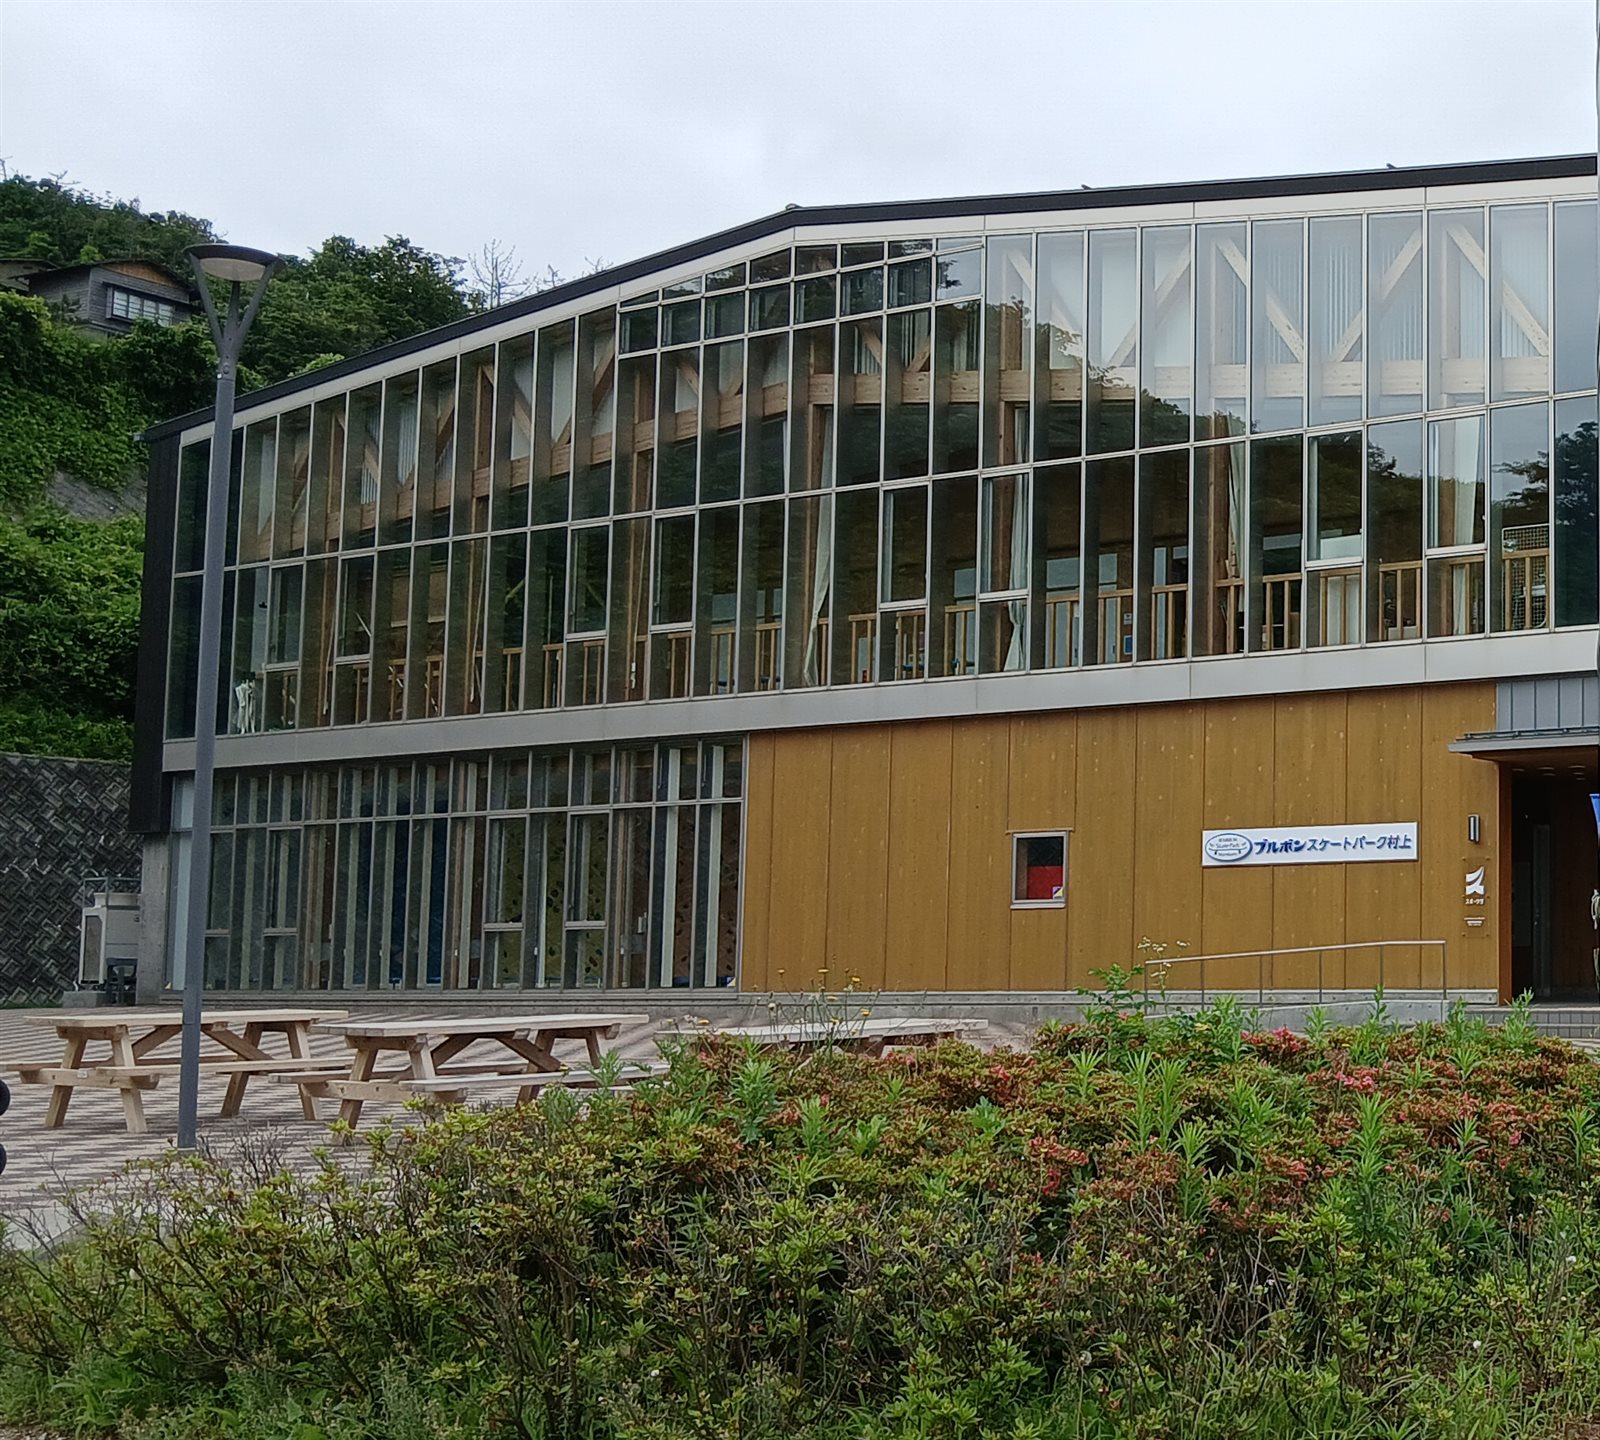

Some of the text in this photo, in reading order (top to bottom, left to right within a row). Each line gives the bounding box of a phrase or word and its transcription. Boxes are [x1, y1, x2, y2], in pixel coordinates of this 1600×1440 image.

[1254, 834, 1412, 855] ブルボンスケートパーク村上
